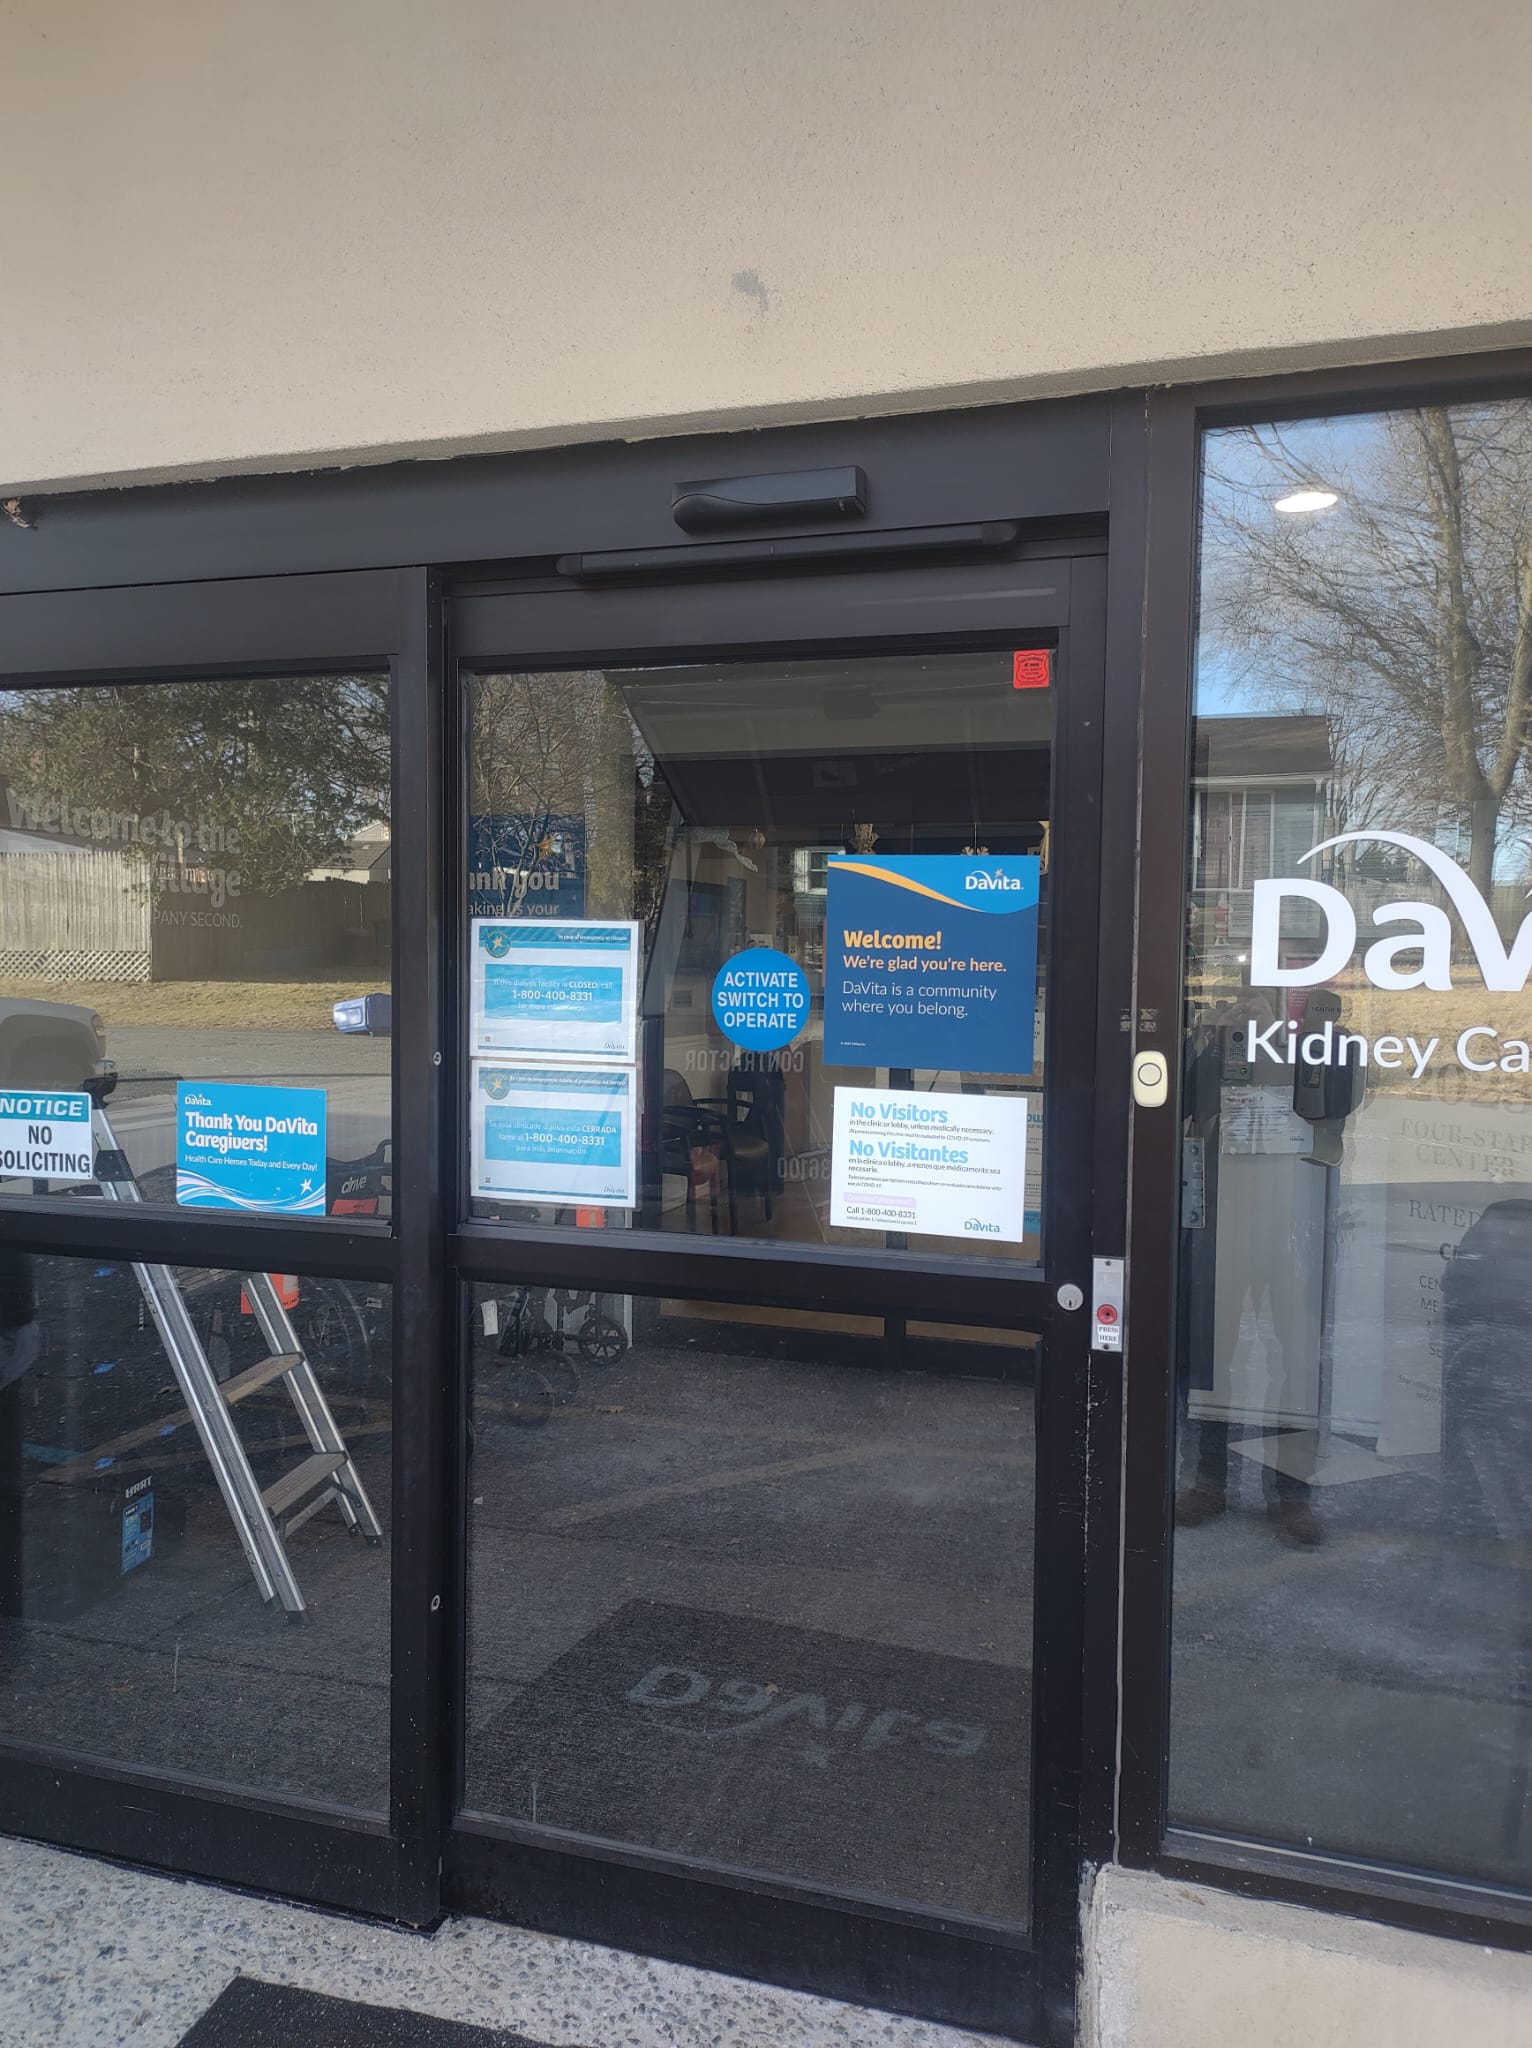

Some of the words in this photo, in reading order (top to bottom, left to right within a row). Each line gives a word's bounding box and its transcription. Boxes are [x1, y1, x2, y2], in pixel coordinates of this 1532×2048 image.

[514, 870, 559, 899] you
[965, 869, 1021, 890] DaVita
[843, 930, 942, 950] Welcome!
[843, 955, 884, 969] We're
[888, 957, 917, 972] glad
[921, 957, 966, 973] you're
[970, 958, 1007, 972] here.
[724, 972, 798, 988] ACTIVATE
[513, 989, 592, 1002] 1-800-400-8331
[717, 992, 779, 1008] SWITCH
[783, 993, 804, 1009] TO
[842, 981, 887, 996] DaVita
[892, 982, 901, 996] is
[906, 987, 914, 996] a
[919, 985, 997, 1001] community
[842, 1000, 884, 1013] where
[888, 1004, 913, 1016] you
[918, 1002, 968, 1019] belong.
[724, 1012, 797, 1029] OPERATE
[1247, 1020, 1439, 1079] Kidney
[1456, 1026, 1530, 1073] Ca
[0, 1098, 83, 1116] NOTICE
[851, 1102, 875, 1118] No
[879, 1103, 948, 1123] Visitors
[186, 1112, 232, 1130] Thank
[235, 1114, 262, 1132] You
[266, 1117, 318, 1136] DaVita
[582, 1125, 617, 1133] CERRADA
[28, 1125, 52, 1145] NO
[186, 1131, 268, 1155] Caregivers!
[525, 1132, 605, 1145] 1-800-400-8331
[850, 1140, 874, 1156] No
[878, 1141, 968, 1164] Visitantes
[185, 1154, 207, 1163] Health
[208, 1155, 224, 1164] Care
[224, 1157, 248, 1165] Heroes
[248, 1158, 268, 1168] Today
[268, 1160, 281, 1168] and
[282, 1161, 301, 1170] Every
[302, 1163, 318, 1172] Day!
[125, 1475, 153, 1499] HART
